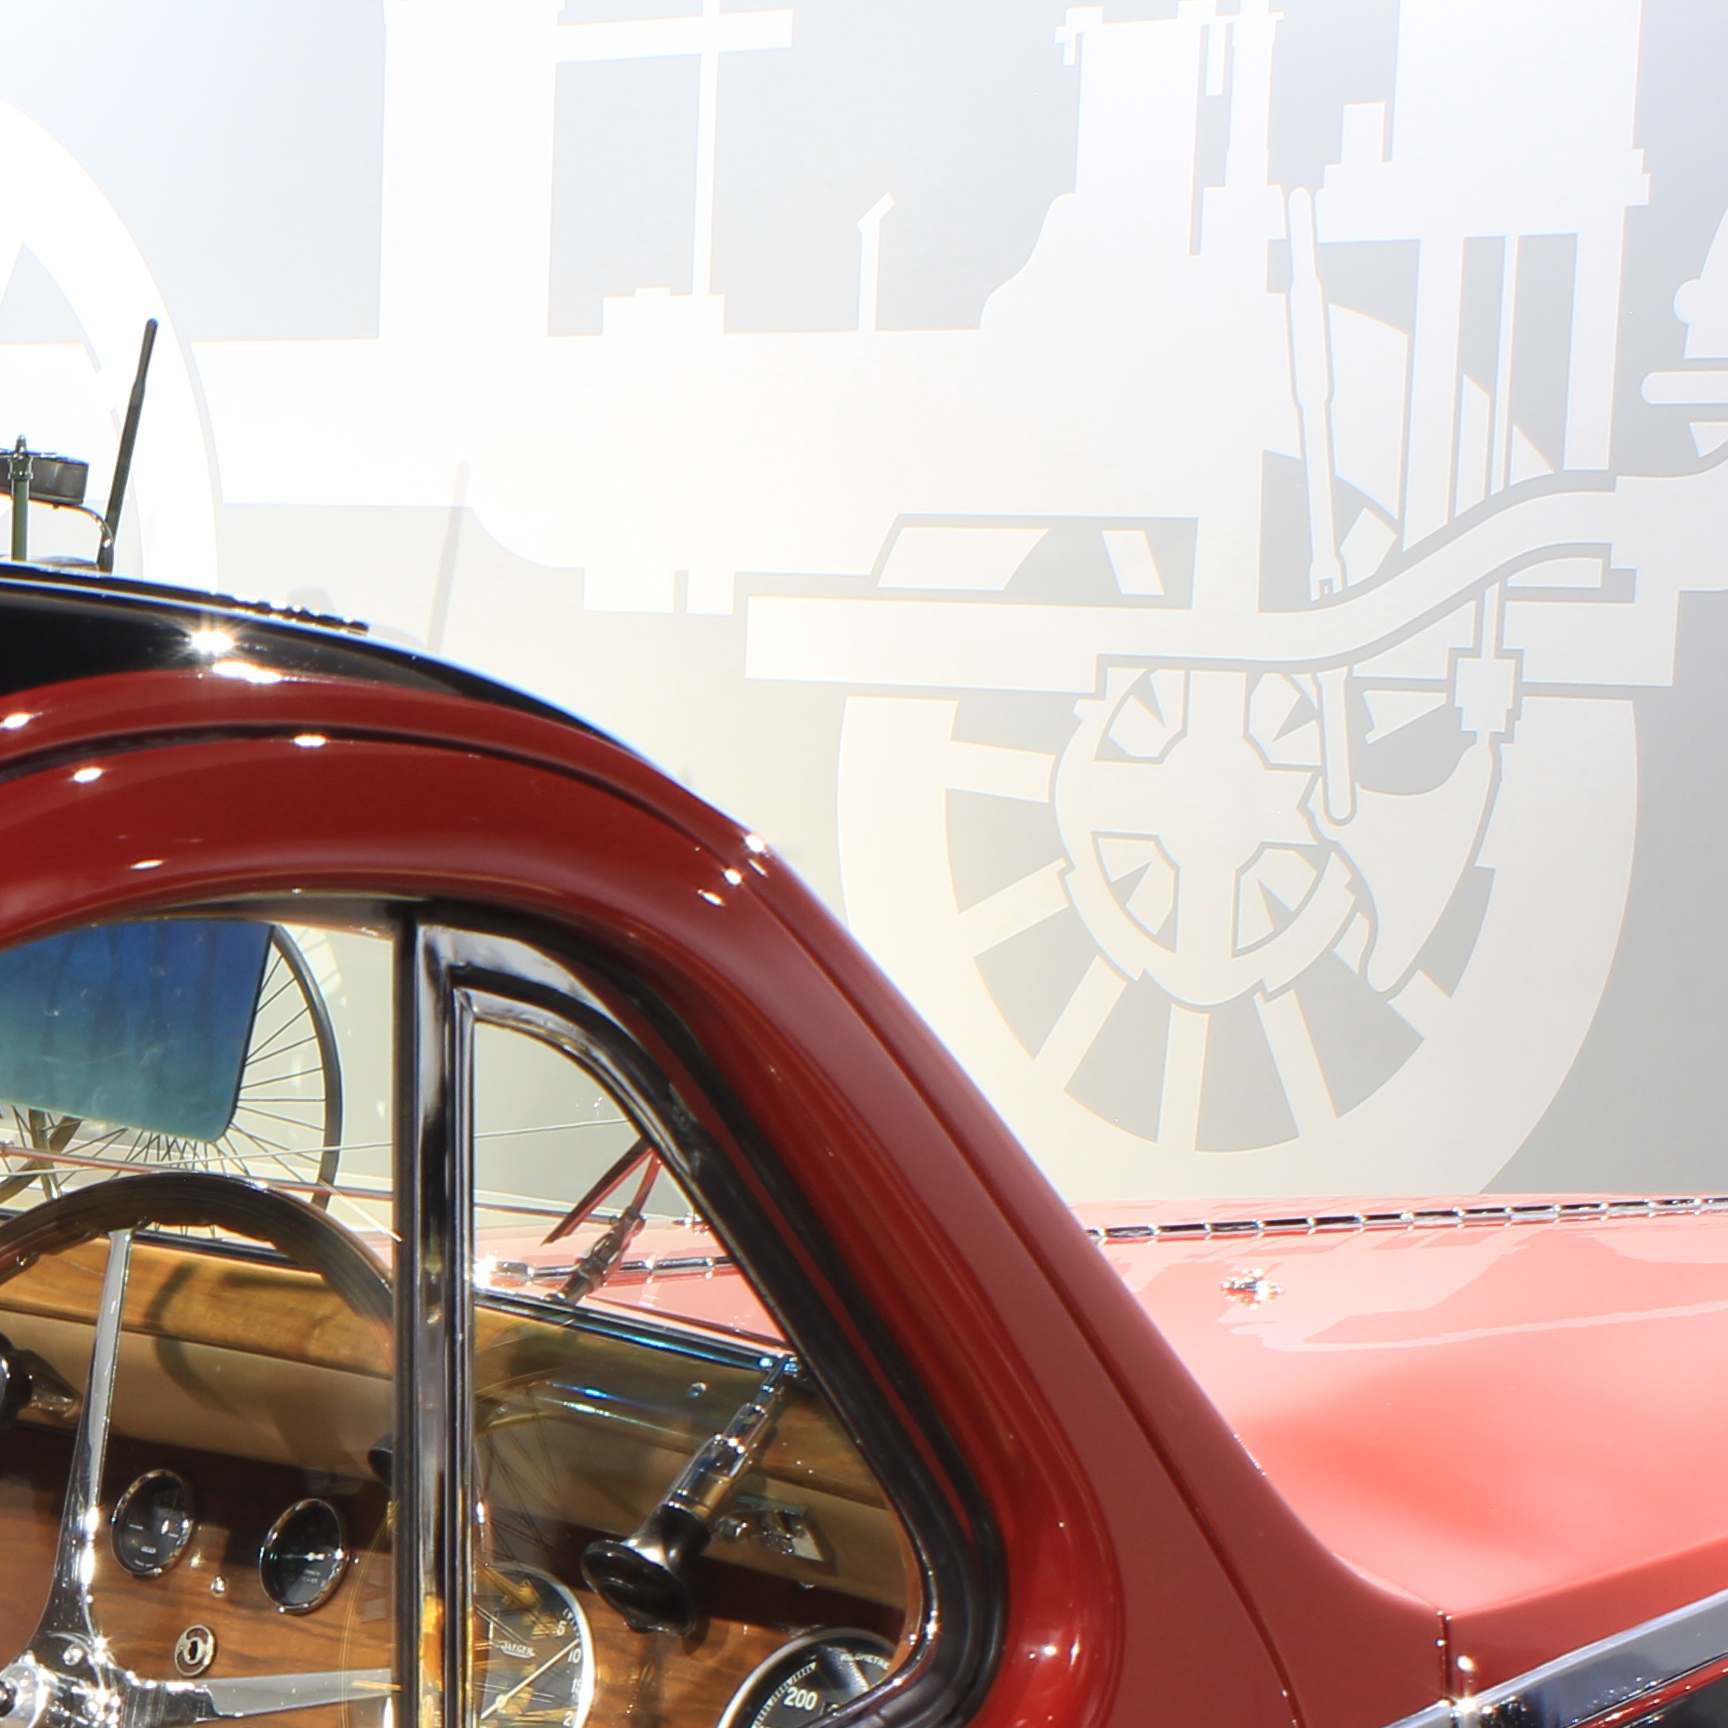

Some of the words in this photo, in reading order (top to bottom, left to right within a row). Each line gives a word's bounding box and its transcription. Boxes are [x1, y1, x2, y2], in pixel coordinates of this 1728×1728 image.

[556, 1620, 567, 1636] 5
[504, 1641, 534, 1656] JAEGER
[567, 1648, 581, 1663] 10
[783, 1686, 818, 1711] 200
